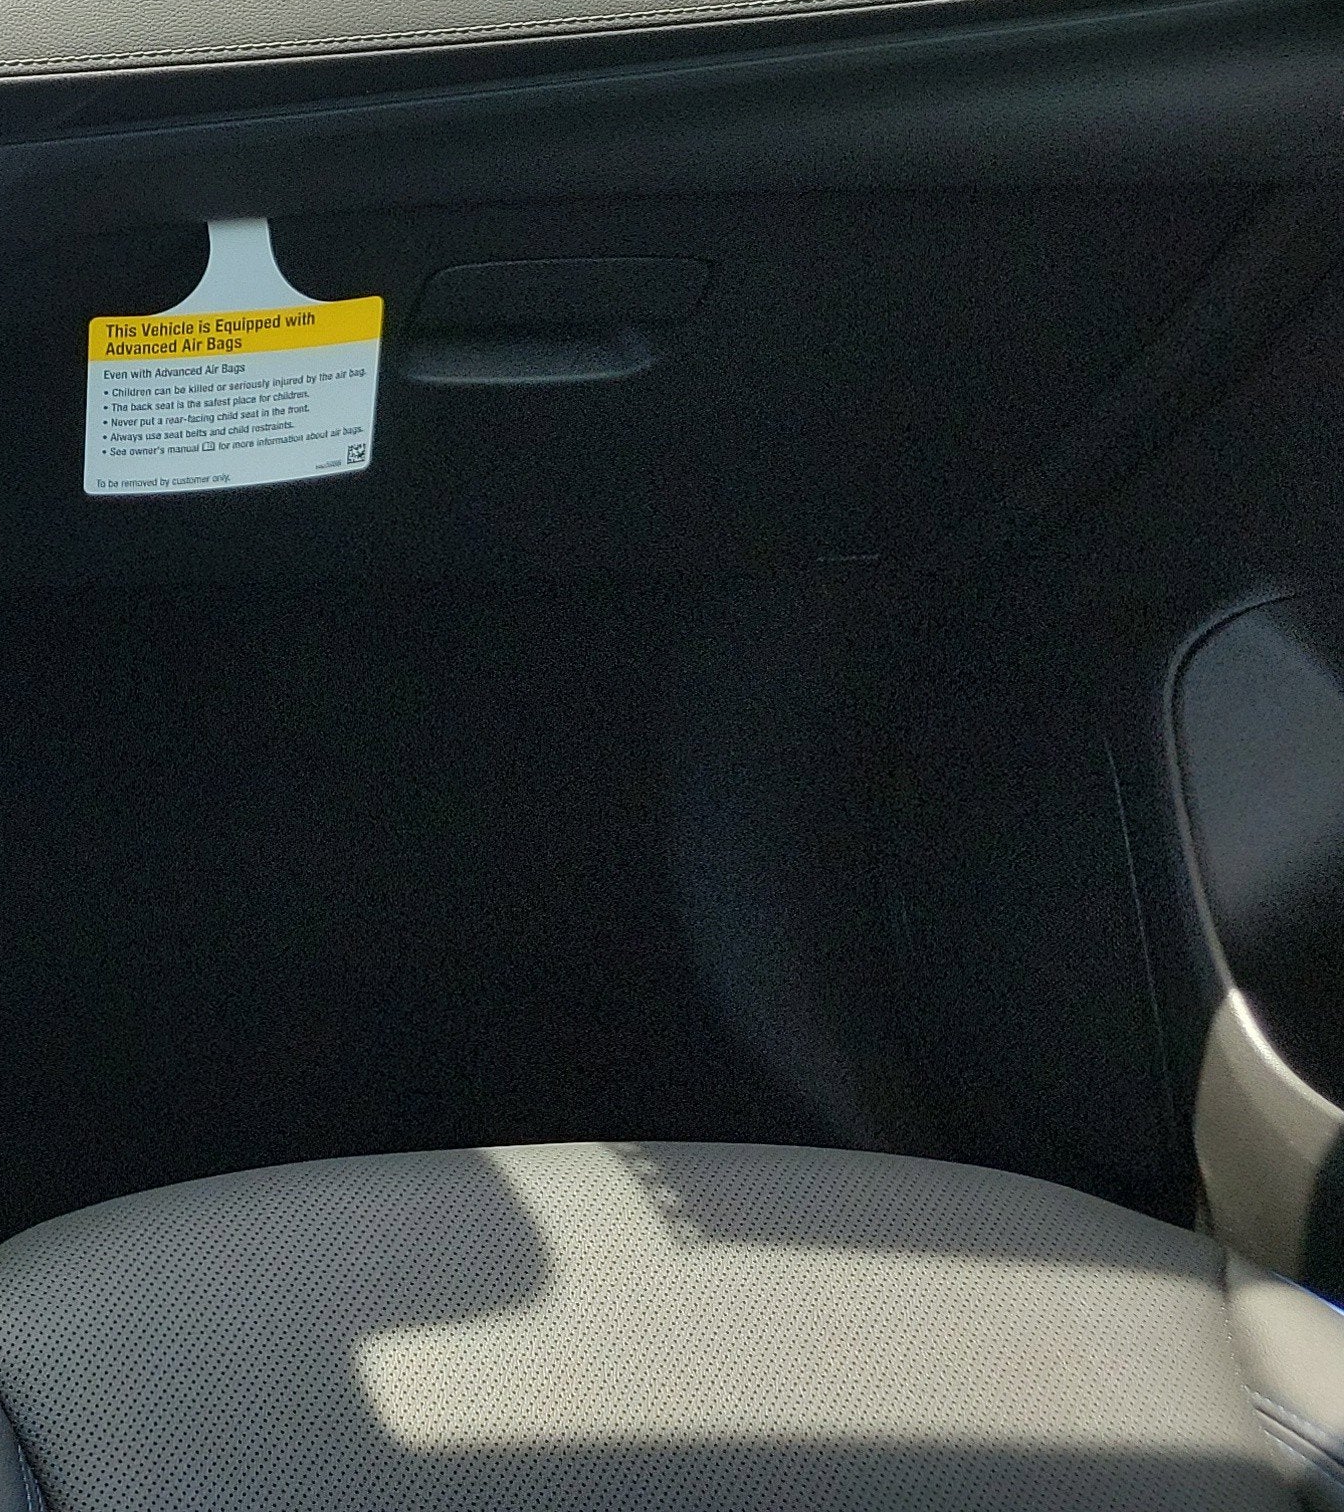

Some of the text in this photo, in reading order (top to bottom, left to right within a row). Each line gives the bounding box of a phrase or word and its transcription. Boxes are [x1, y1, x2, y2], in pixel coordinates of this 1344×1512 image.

[106, 312, 316, 338] This Vehicle is Equipped with
[105, 337, 243, 356] Advanced Air Bags
[103, 363, 246, 380] Even with Advanced Air Bags
[112, 388, 152, 398] Children
[154, 388, 171, 396] can
[174, 386, 186, 395] be
[188, 383, 214, 393] killed
[216, 383, 227, 392] or
[229, 379, 270, 390] seriously
[272, 375, 304, 388] injured
[306, 374, 317, 385] by
[319, 372, 333, 382] the
[335, 370, 347, 380] air
[112, 402, 128, 412] The
[131, 402, 153, 411] back
[154, 400, 174, 410] seat
[176, 399, 185, 409] is
[187, 398, 201, 408] the
[203, 396, 230, 408] safest
[232, 395, 257, 407] place
[258, 394, 272, 404] for
[111, 417, 138, 427] Never
[139, 417, 155, 427] put
[165, 411, 215, 425] rear-facing
[216, 410, 239, 421] child
[240, 409, 259, 419] seat
[261, 408, 270, 418] in
[272, 406, 286, 416] the
[109, 446, 127, 456] See
[129, 444, 165, 455] owner's
[167, 443, 200, 454] manual
[218, 441, 230, 451] for
[232, 439, 255, 449] more
[305, 430, 329, 441] about
[110, 431, 143, 443] Always
[145, 431, 162, 441] use
[163, 430, 183, 440] seat
[185, 427, 207, 437] belts
[209, 426, 226, 436] and
[227, 424, 250, 435] child
[108, 477, 119, 487] be
[121, 476, 158, 487] removed
[159, 475, 171, 487] by
[171, 474, 211, 485] customer
